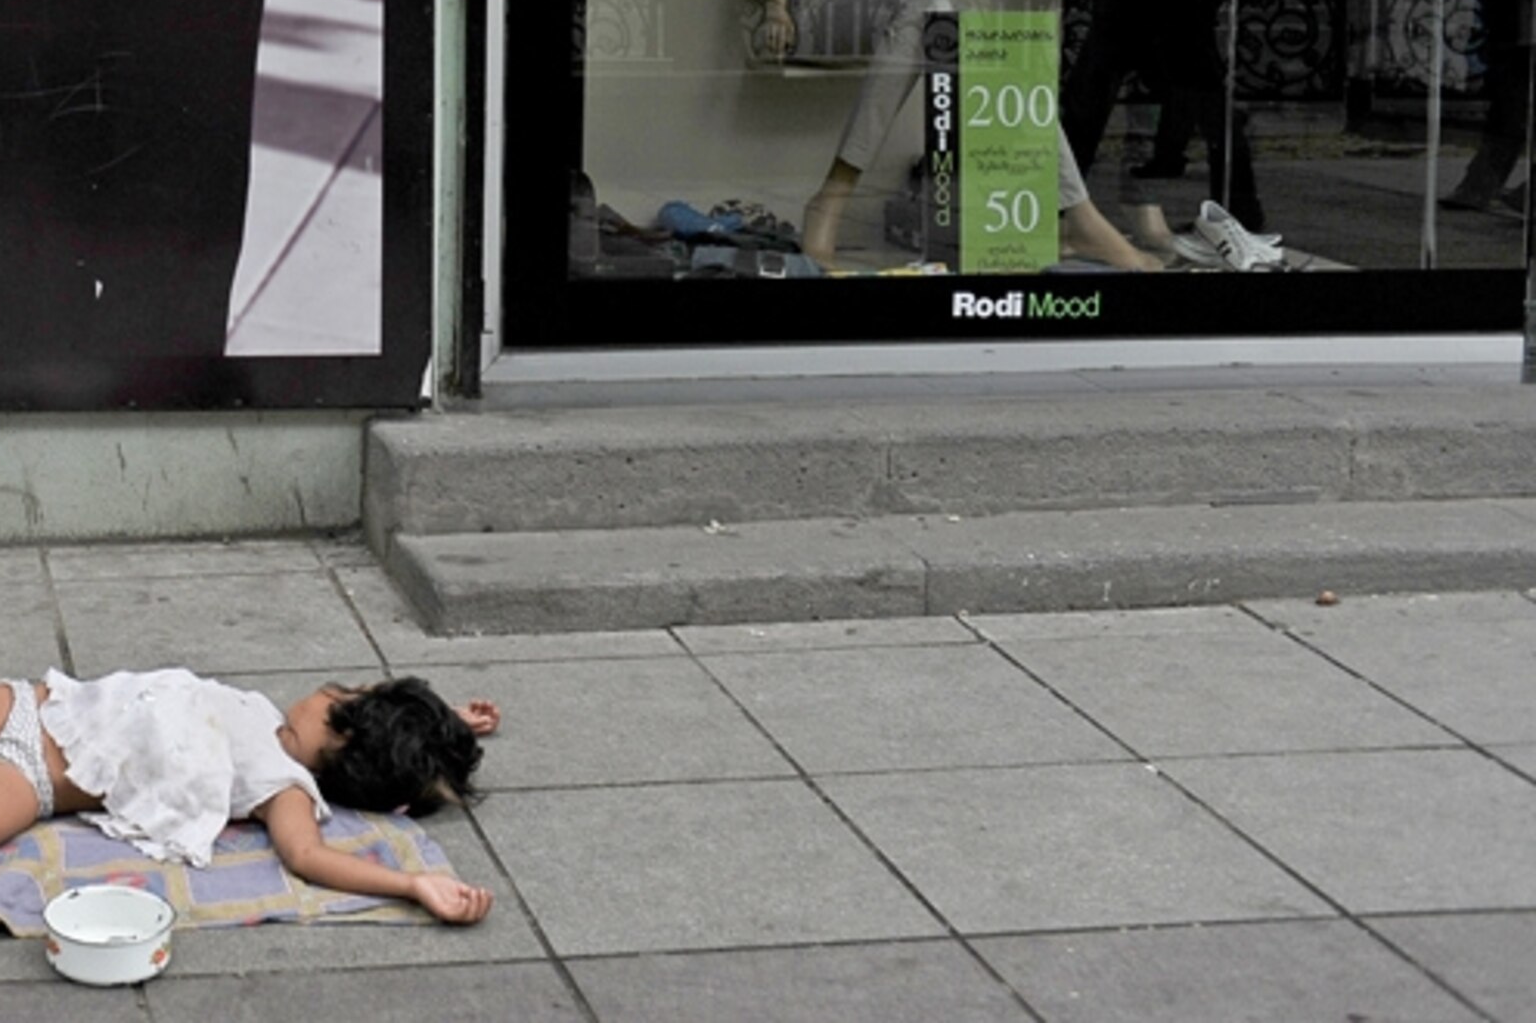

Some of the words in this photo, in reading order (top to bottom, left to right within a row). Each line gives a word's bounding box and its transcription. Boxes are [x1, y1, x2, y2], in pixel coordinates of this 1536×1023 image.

[932, 72, 952, 152] Rodi
[967, 85, 1055, 127] 200
[932, 151, 953, 227] Mood
[984, 189, 1040, 233] 50
[952, 290, 1024, 318] Rodi
[1028, 290, 1101, 318] Mood
